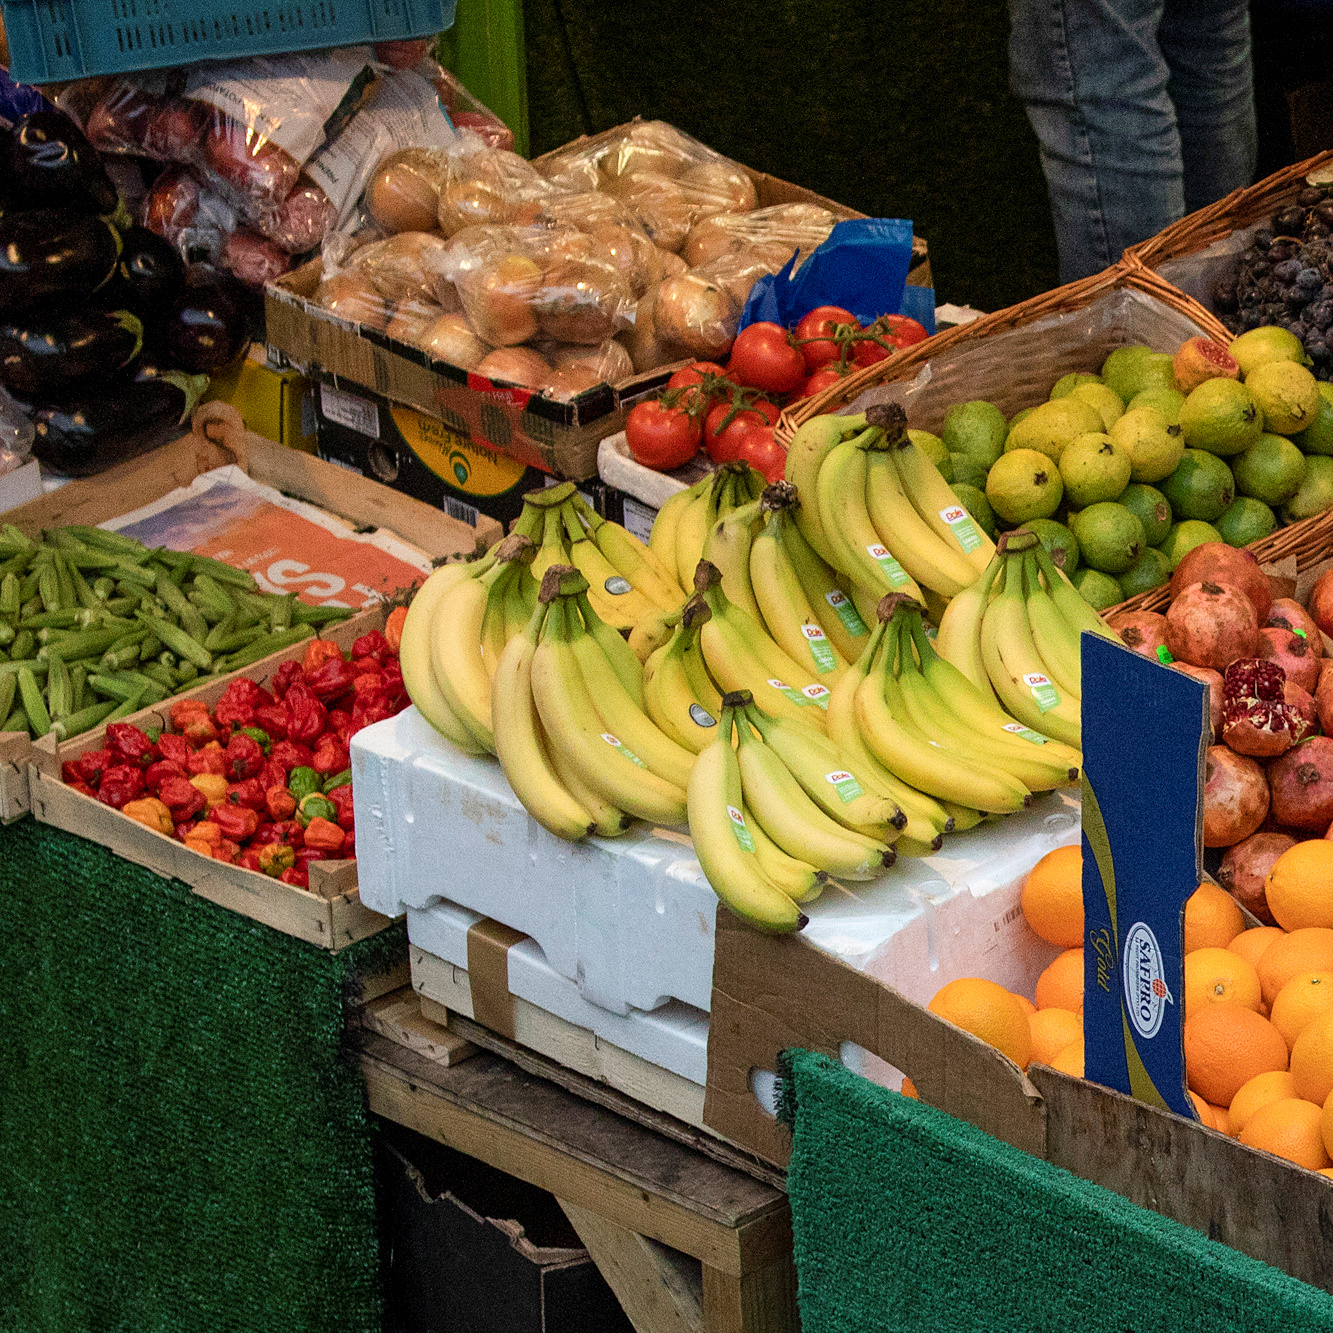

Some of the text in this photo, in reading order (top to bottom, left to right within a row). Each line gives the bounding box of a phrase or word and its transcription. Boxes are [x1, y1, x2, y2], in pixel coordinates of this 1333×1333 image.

[945, 509, 964, 522] Dole
[806, 627, 823, 637] Dole
[1028, 675, 1049, 685] Dole
[809, 685, 825, 696] Dole
[831, 773, 850, 781] Dole
[1090, 929, 1114, 993] Gold
[1139, 937, 1152, 1023] SAFPRO
